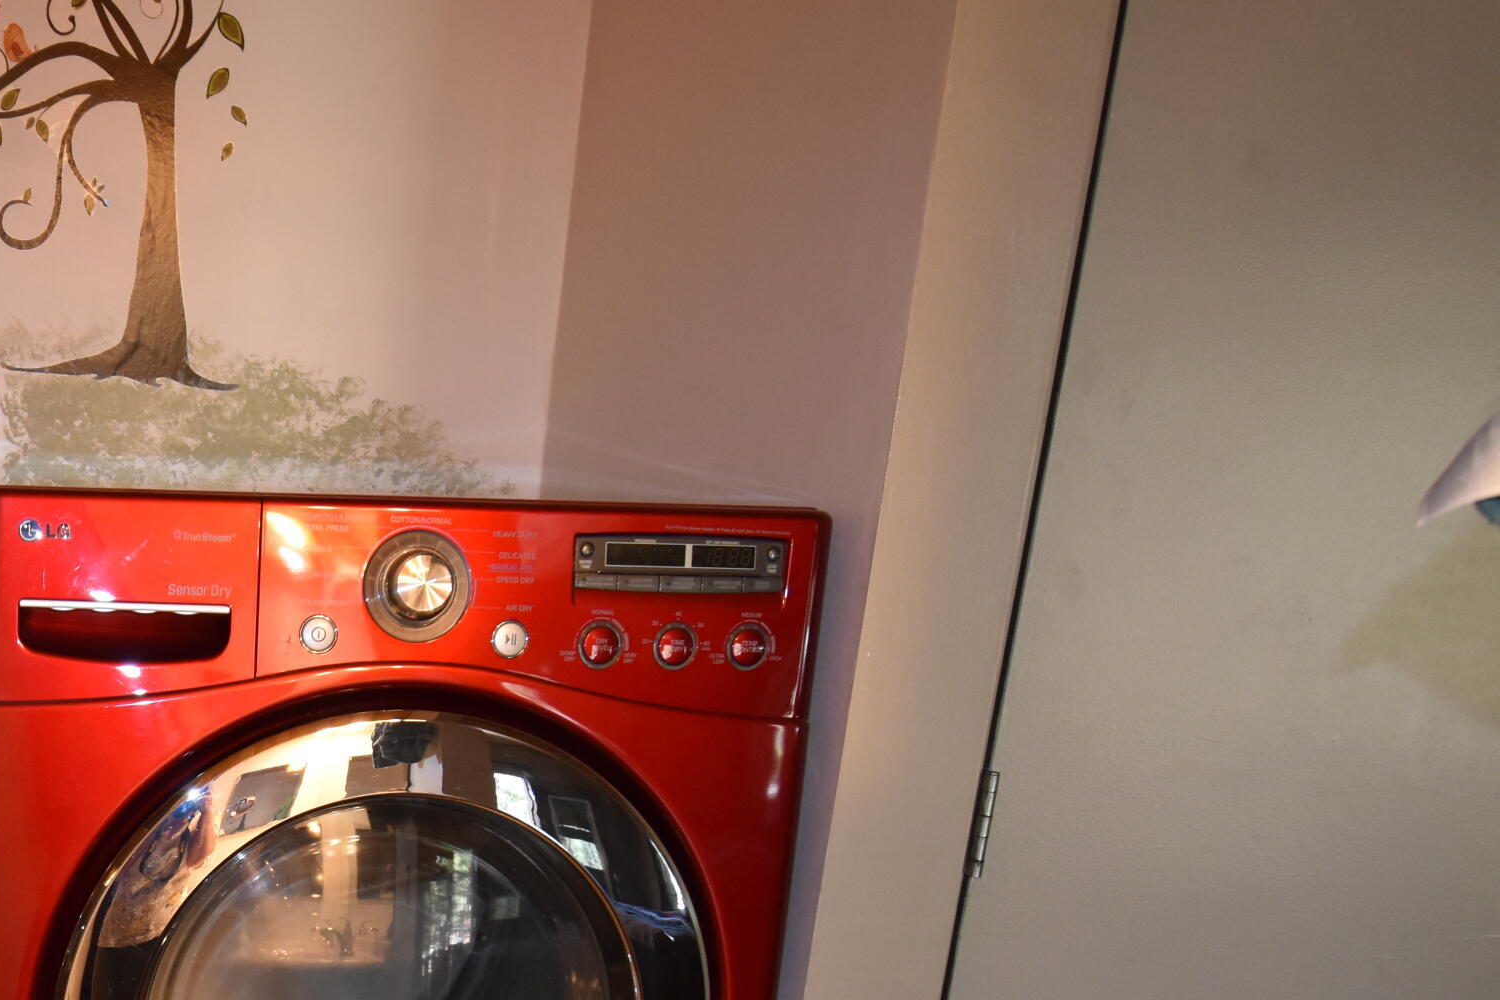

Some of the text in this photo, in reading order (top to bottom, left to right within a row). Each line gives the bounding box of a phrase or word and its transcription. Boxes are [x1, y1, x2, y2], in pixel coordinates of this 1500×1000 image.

[520, 576, 535, 585] DRY
[167, 583, 232, 599] Sensor Dry
[505, 604, 533, 612] AIR DRY
[670, 639, 685, 647] TIME
